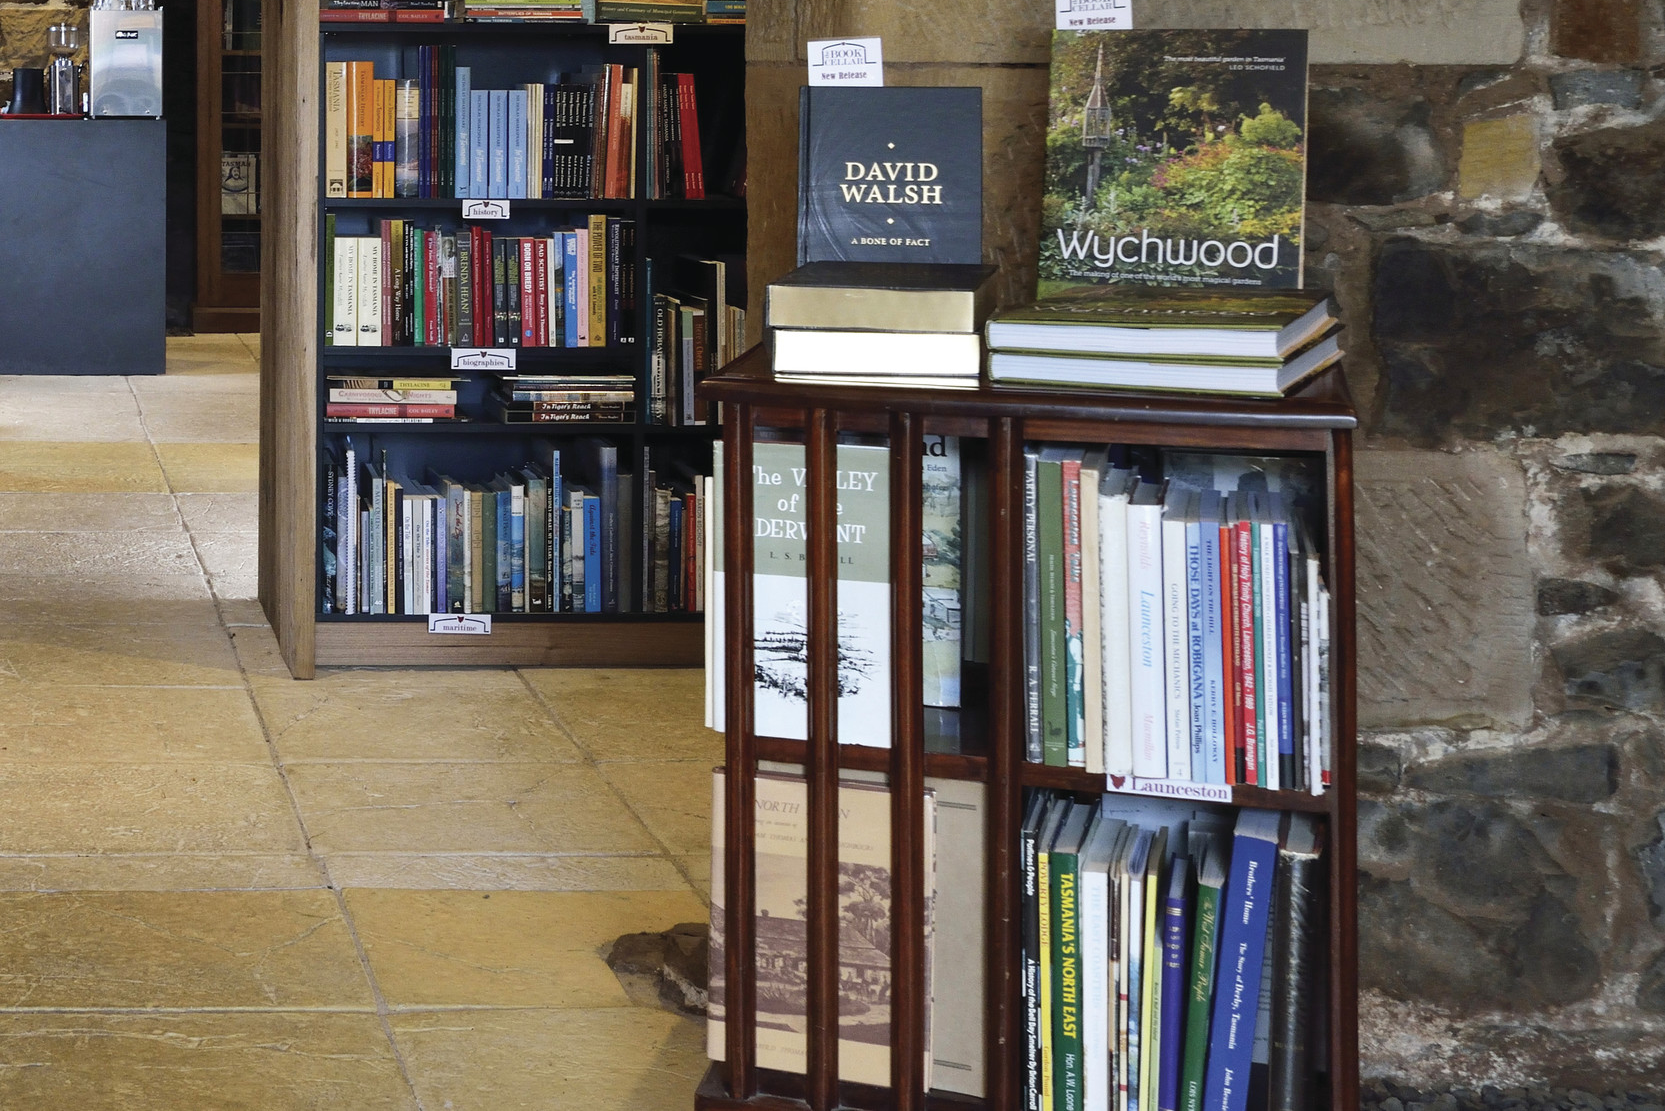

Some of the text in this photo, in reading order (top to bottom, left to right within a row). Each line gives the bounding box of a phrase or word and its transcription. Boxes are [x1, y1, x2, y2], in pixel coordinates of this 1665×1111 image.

[1071, 3, 1113, 12] CELLAR
[1069, 16, 1116, 26] New Release
[824, 58, 864, 66] CELLAR
[830, 49, 862, 58] BOOK
[821, 71, 868, 80] New Release
[332, 69, 343, 113] TASMANIA
[844, 161, 938, 181] DAVID
[840, 184, 943, 204] WALSH
[473, 208, 498, 218] history
[860, 238, 887, 246] BONE
[890, 238, 903, 246] OF
[1056, 228, 1279, 269] Wychwood
[460, 251, 469, 314] BRENDA HEAN?
[462, 358, 504, 368] biographies
[696, 346, 704, 370] Cheers
[927, 463, 947, 472] Eden
[753, 465, 878, 491] he VLEY
[777, 493, 800, 513] of
[755, 518, 866, 544] DERNT
[442, 623, 477, 631] maritime
[1139, 589, 1155, 668] Launceston
[1189, 544, 1203, 699] THOSE DAYS at ROBIGANA
[1192, 702, 1203, 754] Joan Phillips
[1130, 777, 1228, 800] Launceston
[1242, 860, 1258, 925] Brothers' Home
[1060, 872, 1076, 1038] TASMANIA'S NORTH EAST
